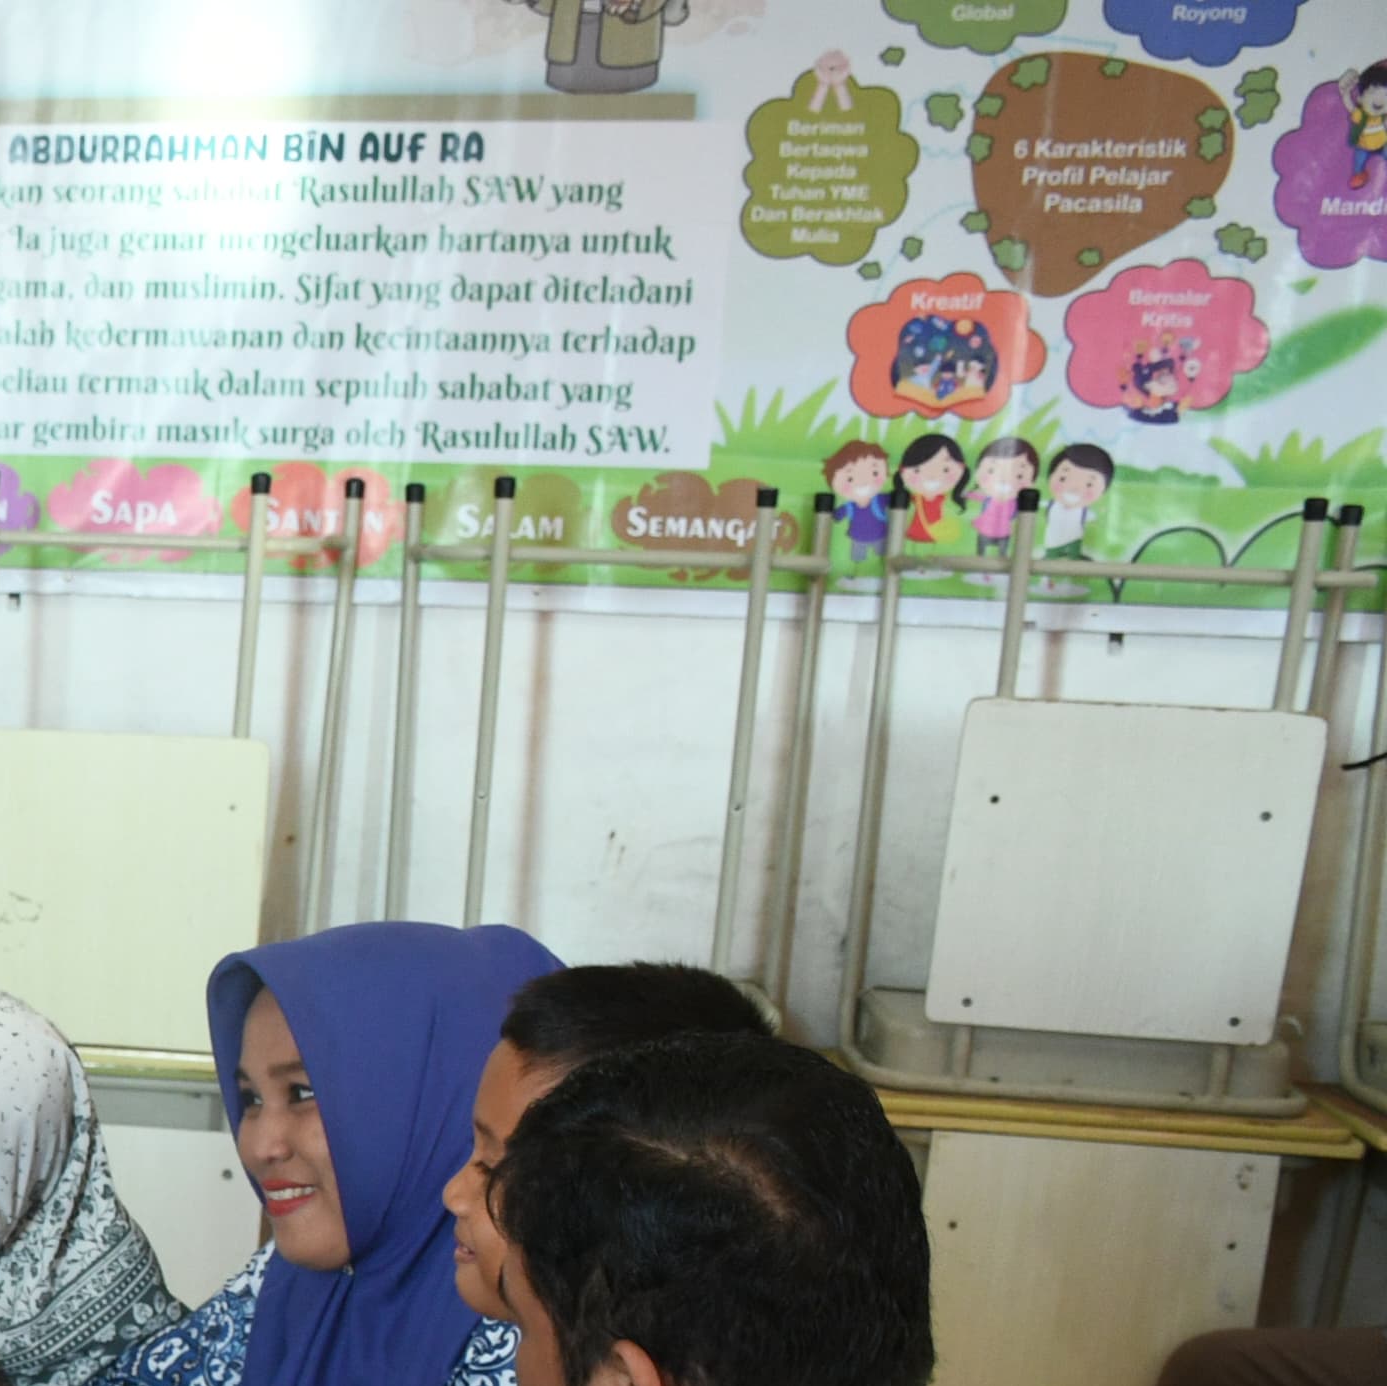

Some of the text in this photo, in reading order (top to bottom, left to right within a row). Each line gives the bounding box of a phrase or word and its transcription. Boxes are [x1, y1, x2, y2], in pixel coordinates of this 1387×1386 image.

[951, 4, 1015, 22] Global
[1172, 5, 1246, 25] Royong
[787, 119, 866, 136] Beriman
[9, 134, 267, 165] ABDURRAHMAN
[440, 132, 485, 162] RA
[779, 141, 869, 159] Bertaqwa
[1014, 138, 1187, 159] 6 Karakteristik
[787, 163, 857, 182] Kepada
[1022, 165, 1173, 190] Profil Pelajar
[52, 180, 162, 206] seorang
[294, 175, 455, 206] Rasulullah
[463, 174, 543, 206] SAW
[550, 179, 625, 211] yang
[1043, 192, 1144, 213] Pacasila
[46, 228, 111, 258] juga
[117, 231, 205, 258] gemar
[218, 225, 427, 258] mengeluarkan
[438, 225, 571, 260] hartanya
[581, 225, 677, 260] untuk
[84, 273, 134, 300] dan
[296, 272, 362, 305] Sifat
[369, 278, 441, 309] yang
[450, 273, 534, 309] dapat
[542, 273, 693, 308] diteladani
[911, 292, 984, 311] Kreatif
[65, 320, 283, 352] kedermawanan
[292, 322, 344, 350] dan
[355, 322, 552, 360] kecintaannya
[561, 326, 696, 363] terhadap
[77, 368, 214, 401] termasuk
[218, 369, 305, 397] dalam
[315, 371, 427, 405] sepuluh
[438, 372, 551, 403] sahabat
[557, 381, 633, 410] yang
[33, 415, 146, 446] gembira
[157, 417, 248, 449] masuk
[258, 425, 334, 452] surga
[346, 418, 405, 449] oleh
[415, 420, 576, 454] Rasulullah
[264, 500, 383, 533] SANTN
